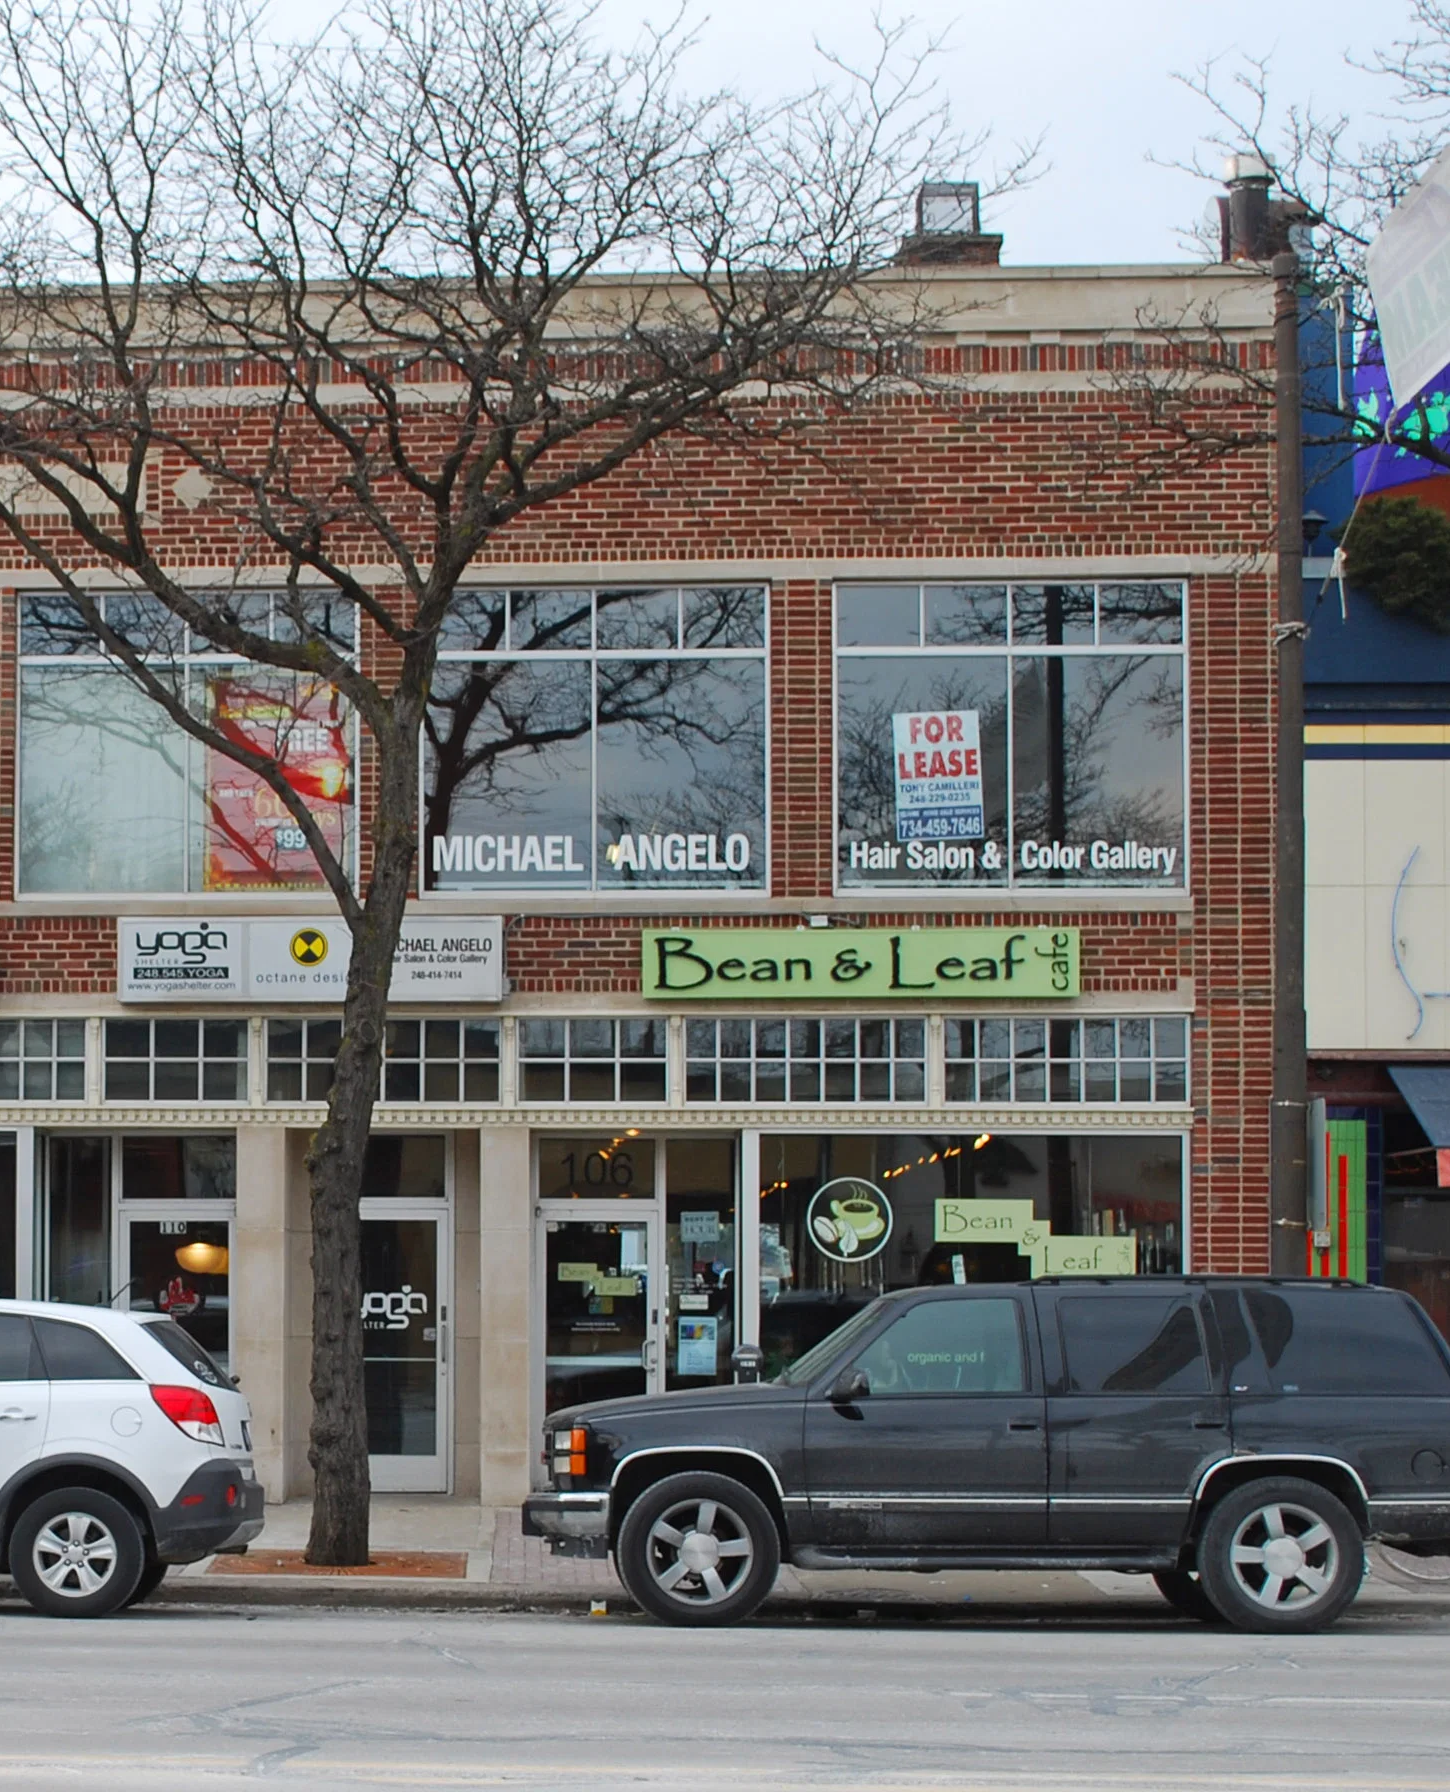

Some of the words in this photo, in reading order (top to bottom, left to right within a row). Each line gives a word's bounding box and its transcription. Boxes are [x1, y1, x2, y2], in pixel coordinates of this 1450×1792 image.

[909, 715, 964, 745] FOR
[900, 749, 979, 780] LEASE
[276, 828, 306, 849] $99
[900, 816, 981, 838] 734-459-7646
[433, 834, 584, 872] MICHAEL
[615, 833, 750, 872] ANGELO
[850, 841, 901, 869] Hair
[906, 840, 974, 870] Salon
[981, 840, 1002, 869] &
[1021, 840, 1086, 870] Color
[1091, 840, 1177, 876] Gallery
[136, 922, 228, 965] yoga
[396, 938, 439, 952] CHAEL
[441, 938, 493, 952] ANGELO
[136, 967, 226, 979] 248.545.YOGA
[404, 954, 426, 964] Salon
[437, 954, 457, 964] Color
[459, 954, 488, 967] Gallery
[654, 936, 812, 990] Bean
[830, 948, 872, 982] &
[889, 934, 1026, 990] Leaf
[127, 981, 237, 993] www.yogashelter.com
[256, 972, 307, 984] octane
[560, 1152, 634, 1188] 106
[161, 1222, 187, 1233] 110
[943, 1204, 1013, 1233] Bean
[1022, 1228, 1040, 1246] &
[1044, 1245, 1103, 1274] Leaf
[361, 1285, 428, 1330] oga
[907, 1351, 951, 1364] organic
[954, 1351, 978, 1362] and
